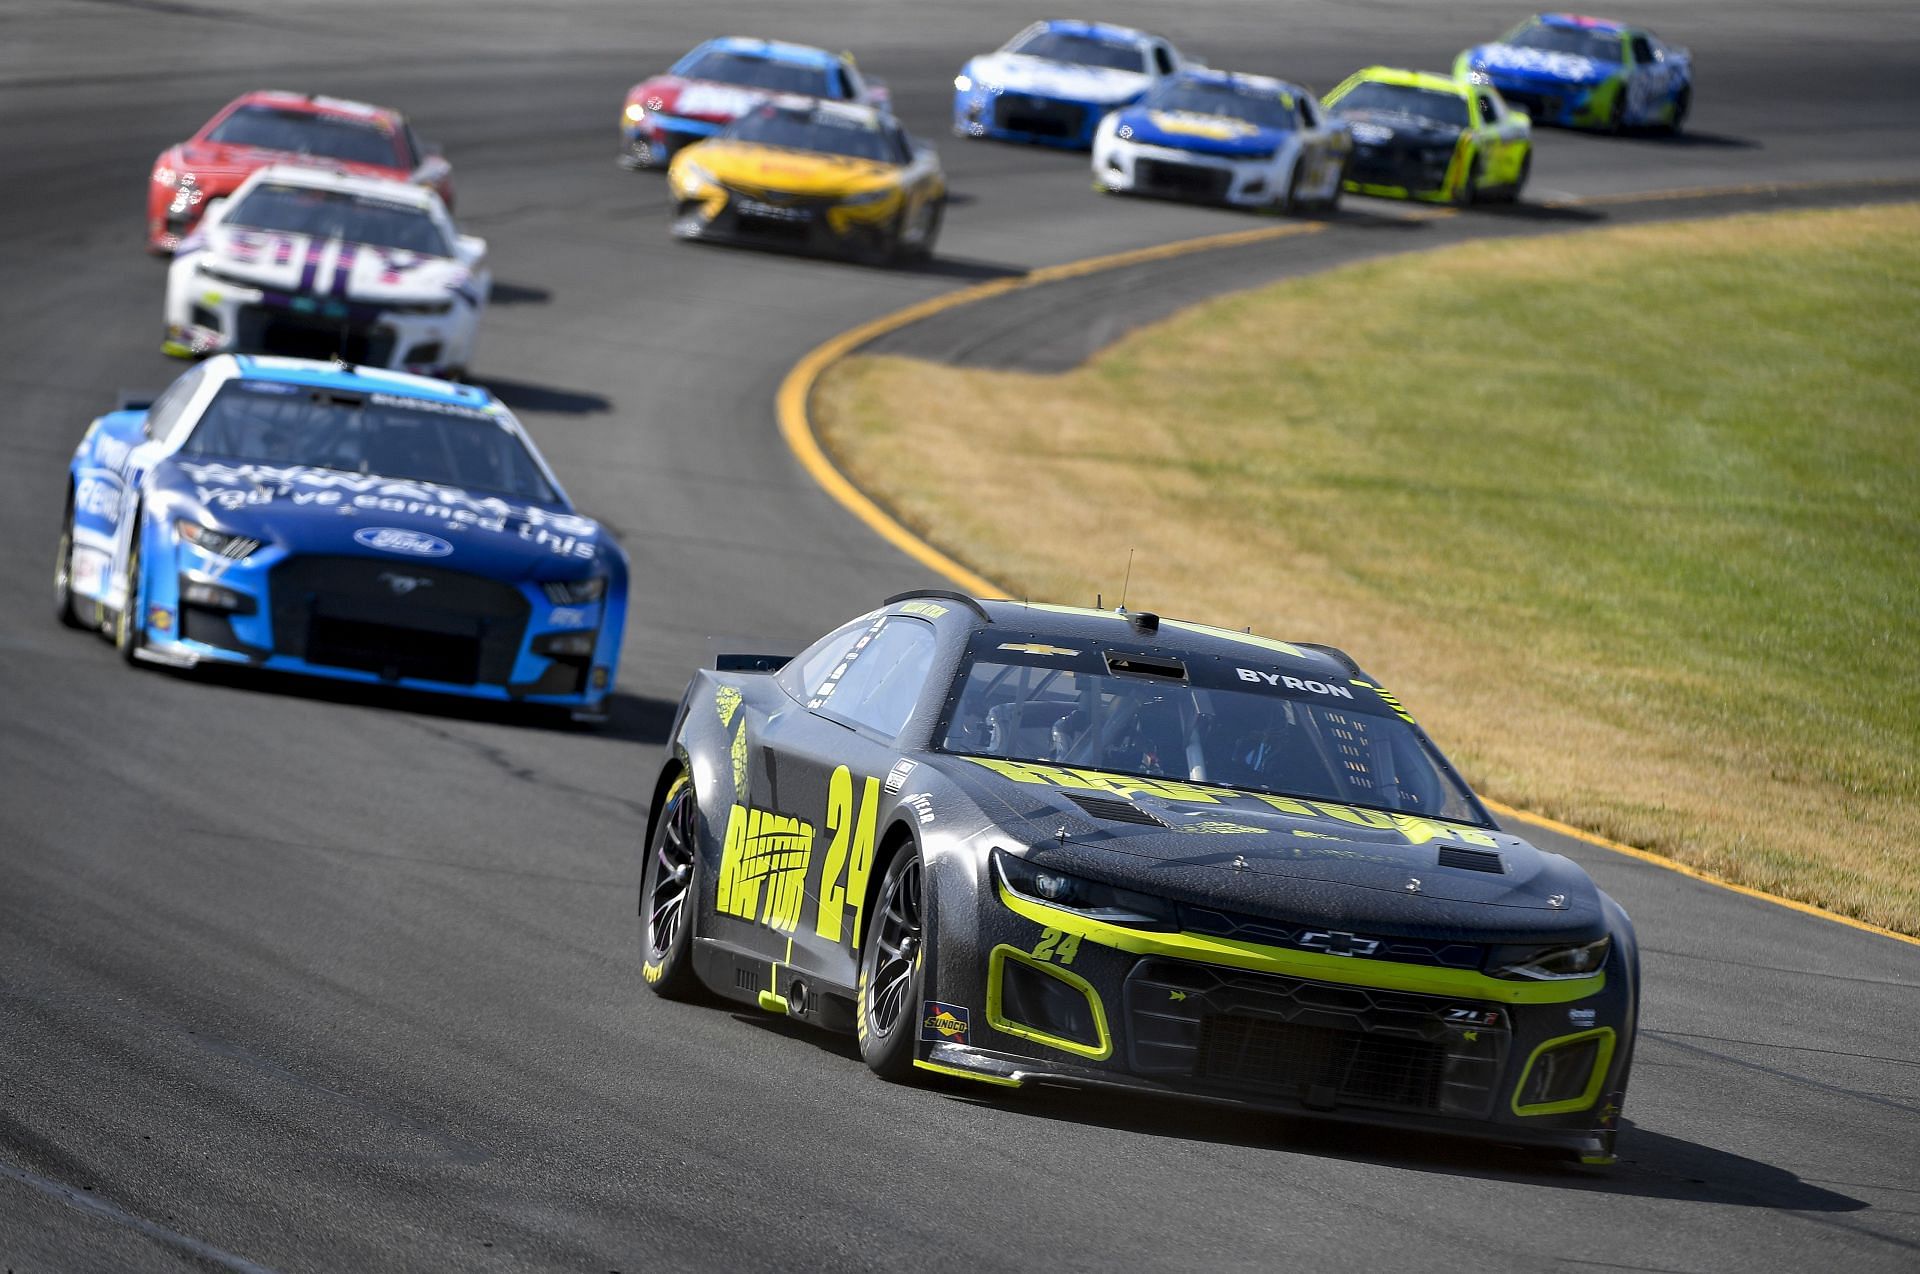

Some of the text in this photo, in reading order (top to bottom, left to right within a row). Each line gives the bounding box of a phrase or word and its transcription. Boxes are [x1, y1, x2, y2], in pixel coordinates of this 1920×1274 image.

[197, 484, 596, 559] You've earned this
[371, 529, 436, 552] Ford
[1236, 667, 1354, 699] BYRON
[716, 803, 815, 933] RAPTOR
[816, 764, 880, 949] 24
[1031, 926, 1086, 965] 24
[926, 1016, 967, 1033] SUNOCO
